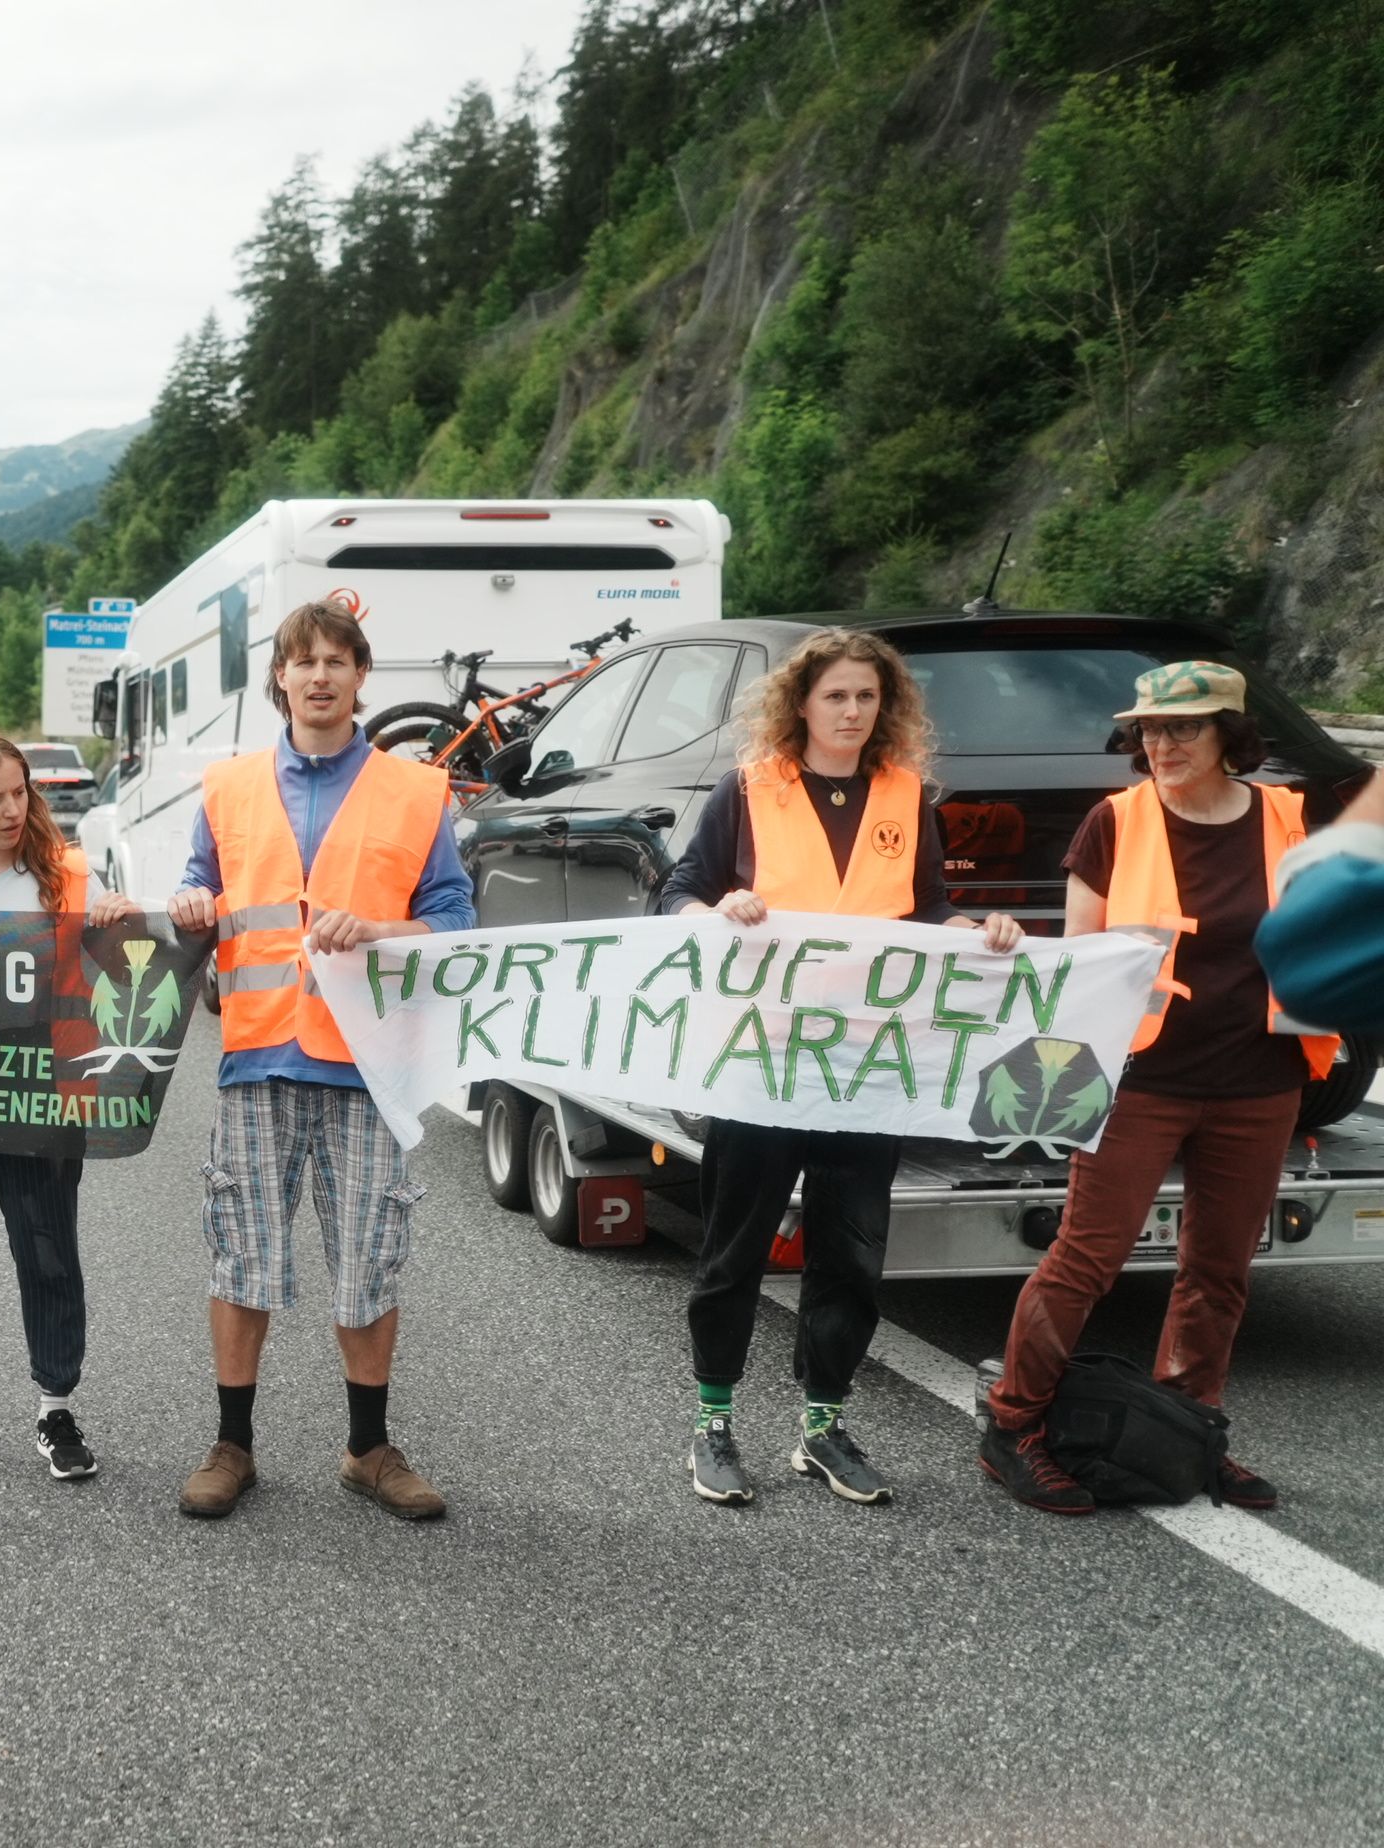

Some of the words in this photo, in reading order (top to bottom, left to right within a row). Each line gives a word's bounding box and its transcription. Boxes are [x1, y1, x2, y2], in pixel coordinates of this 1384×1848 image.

[597, 589, 637, 599] EURA
[641, 589, 680, 599] MOBIL
[366, 934, 623, 1019] HÖRT
[636, 932, 852, 1004] AUF
[864, 945, 1073, 1034] DEN
[457, 994, 1000, 1109] KLIMARAT
